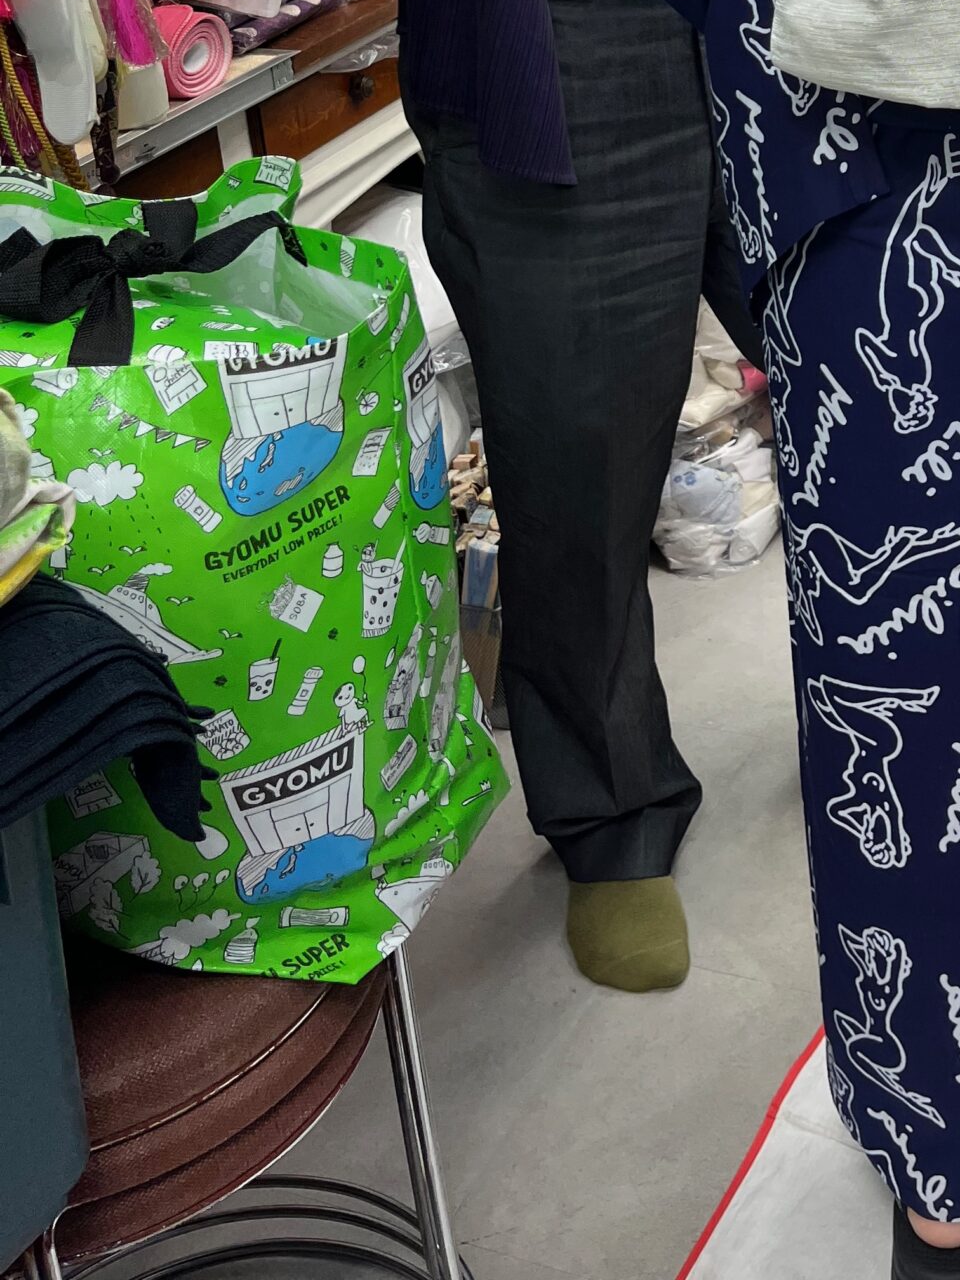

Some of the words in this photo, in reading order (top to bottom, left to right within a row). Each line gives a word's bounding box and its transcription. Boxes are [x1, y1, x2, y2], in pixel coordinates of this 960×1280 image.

[791, 362, 854, 509] Monica
[204, 521, 283, 571] GYOMU
[287, 485, 351, 534] SUPER
[222, 549, 280, 584] EVERYDAY
[282, 536, 305, 556] LOW
[288, 591, 309, 621] SOBA
[242, 745, 349, 805] GYOMU
[280, 932, 351, 977] SUPER
